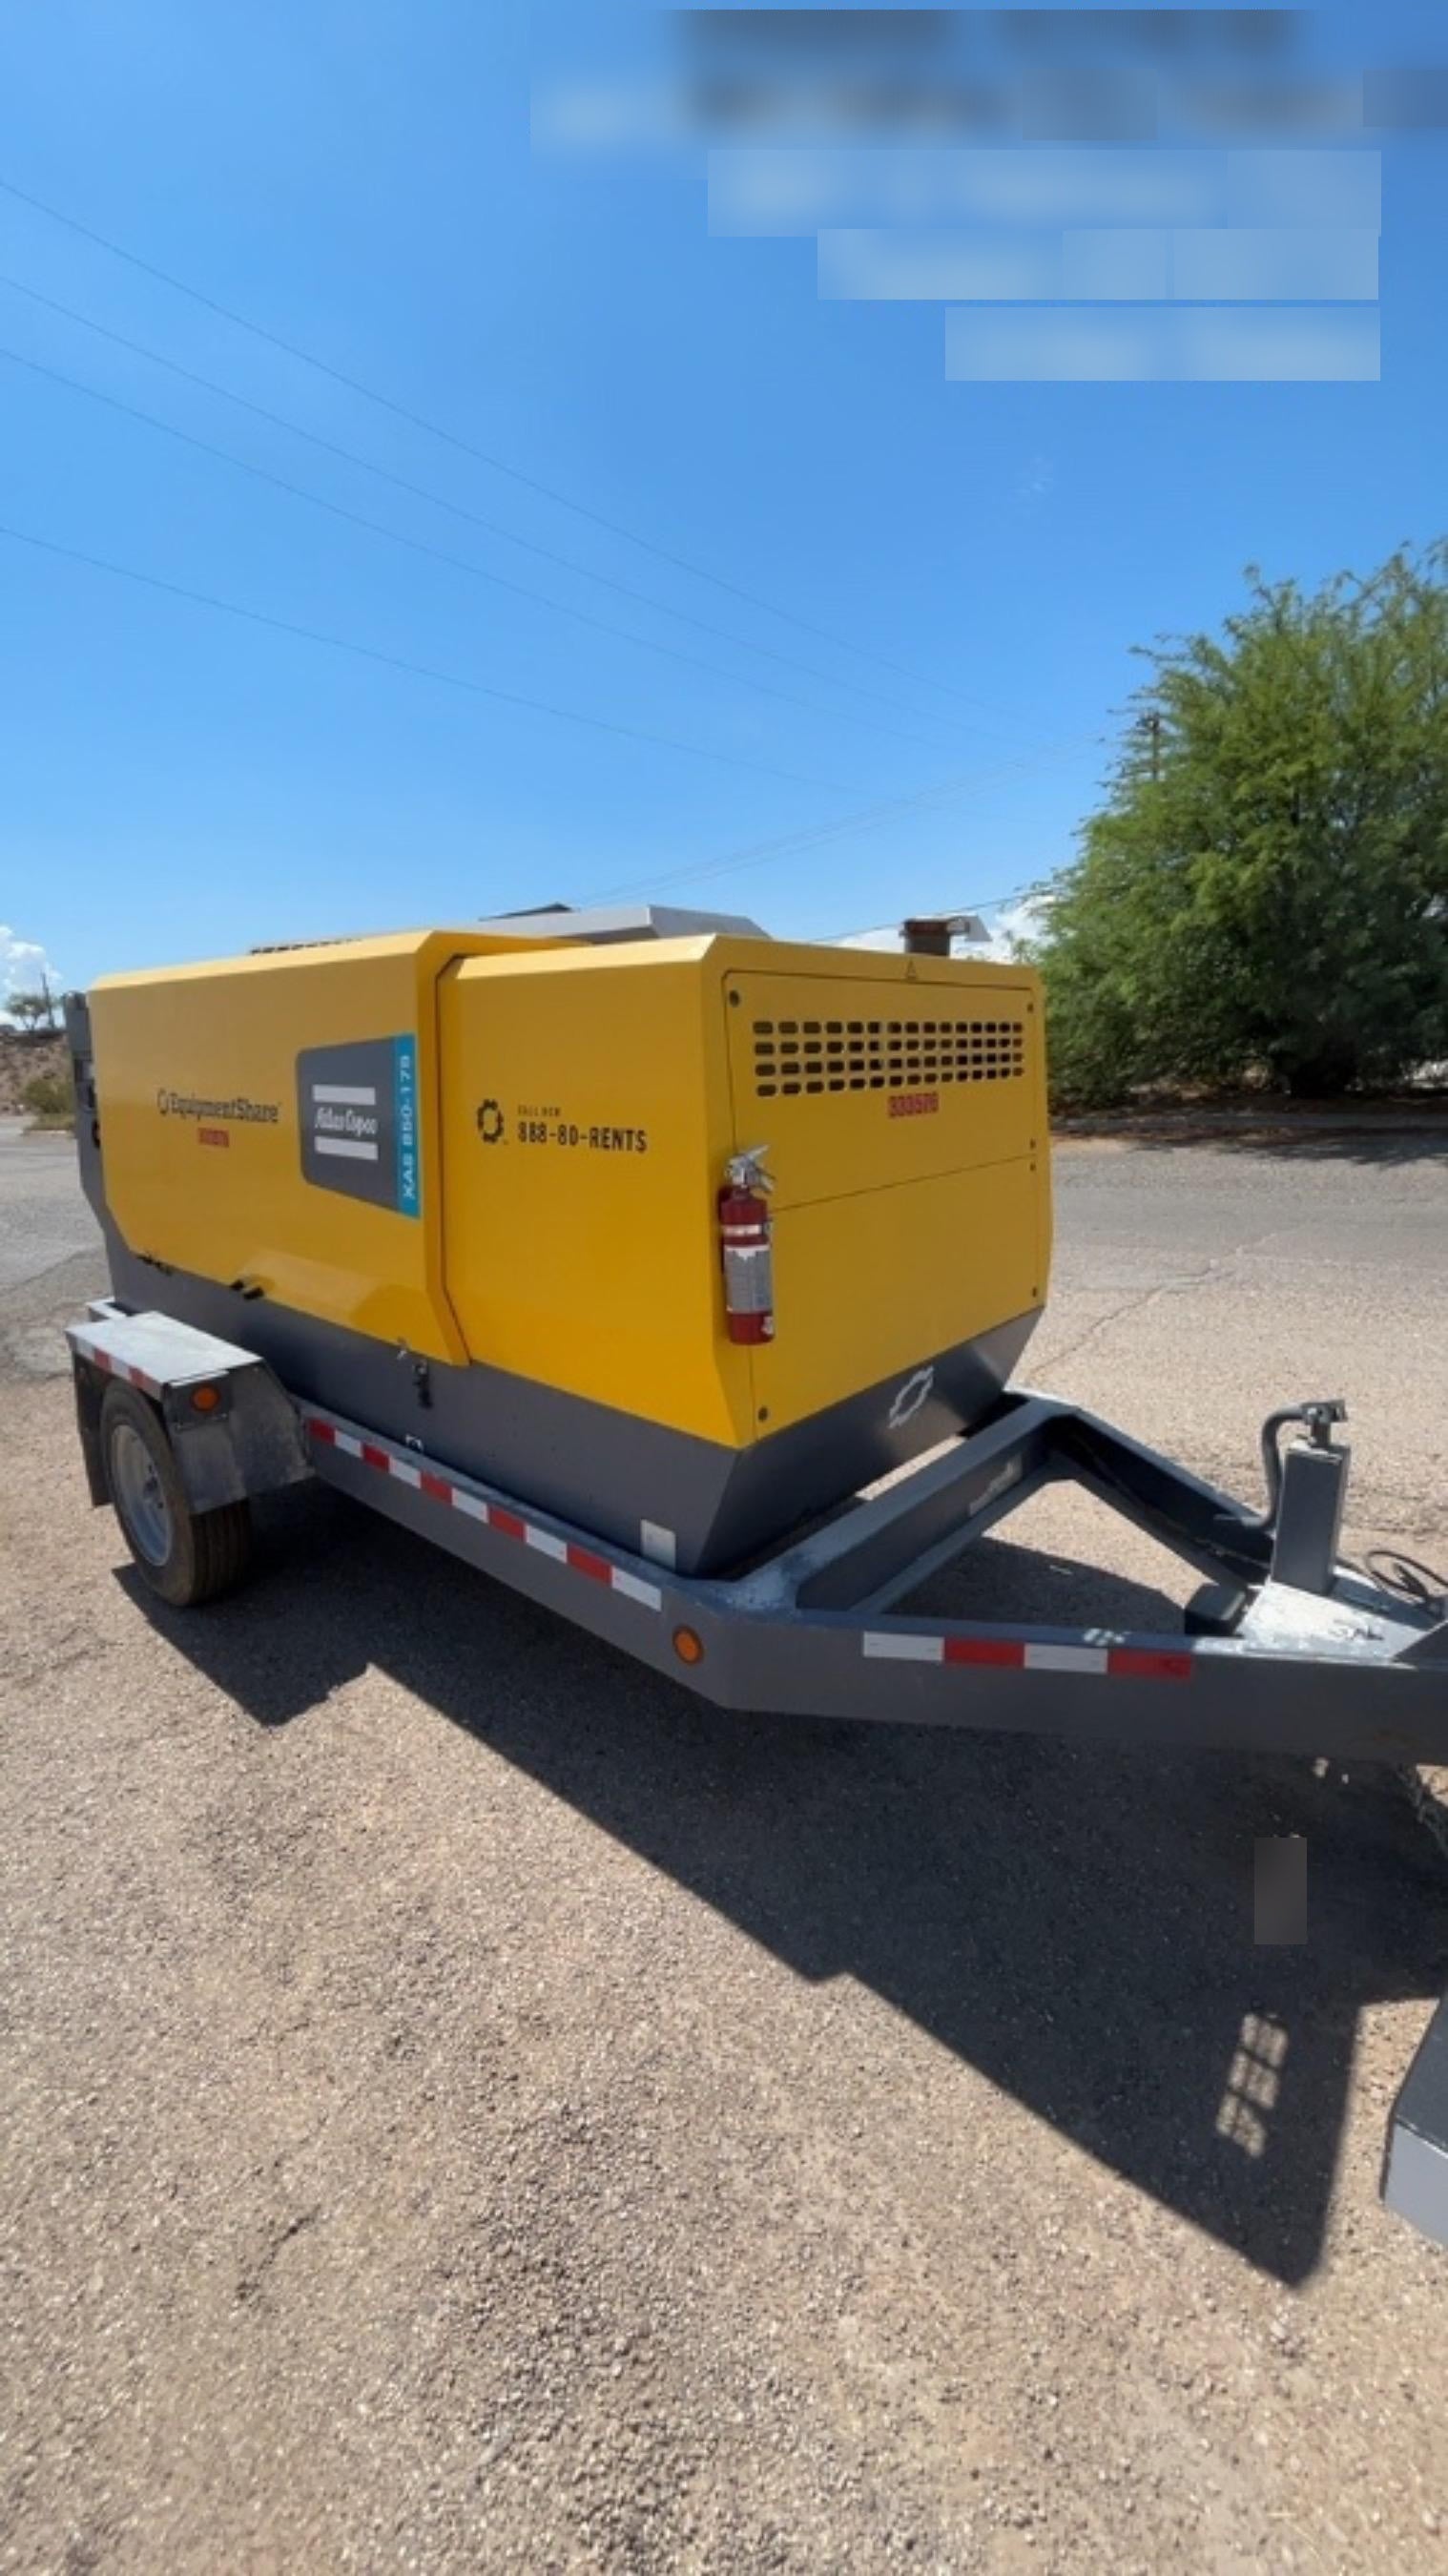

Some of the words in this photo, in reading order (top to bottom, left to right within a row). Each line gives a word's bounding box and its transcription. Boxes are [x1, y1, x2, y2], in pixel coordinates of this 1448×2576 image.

[171, 1091, 279, 1124] EquipmentShare
[314, 1106, 344, 1131] Atlas
[345, 1108, 378, 1137] Copco
[517, 1121, 648, 1153] 888-80-RENTS
